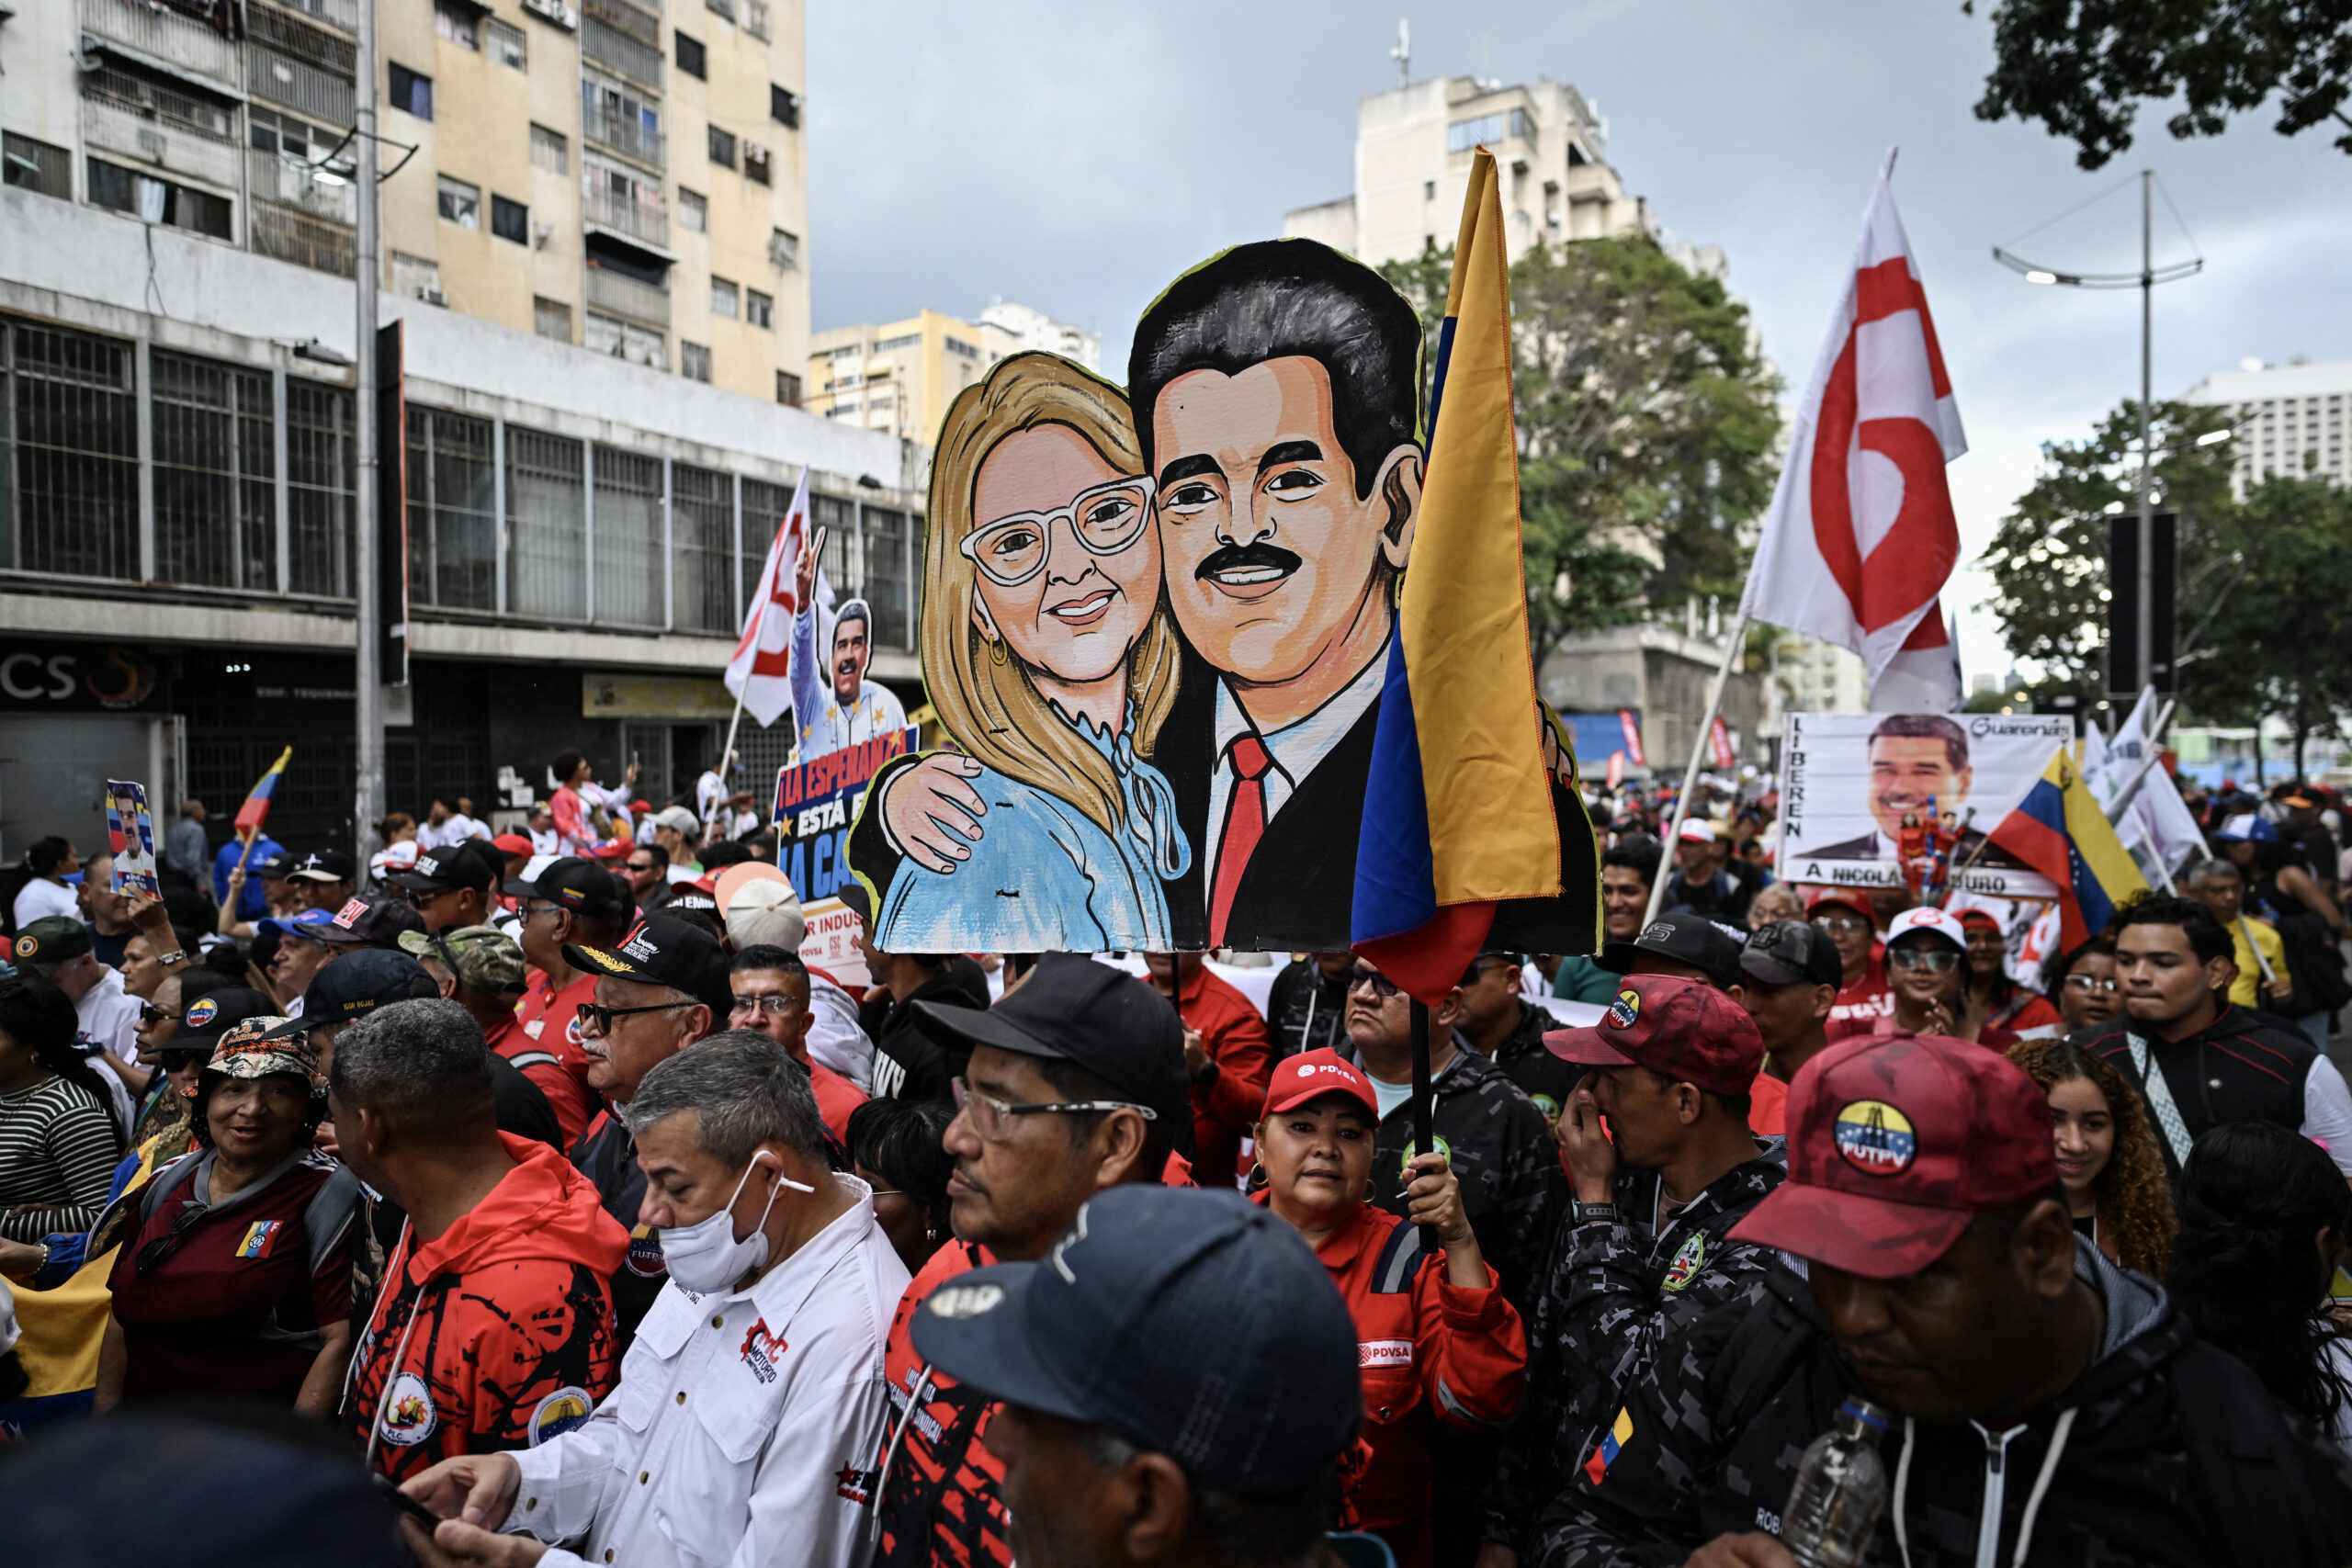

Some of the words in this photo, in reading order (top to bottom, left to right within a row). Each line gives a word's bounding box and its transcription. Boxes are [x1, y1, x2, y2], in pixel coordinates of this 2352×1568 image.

[797, 789, 846, 838] ESTÁ
[851, 791, 865, 822] E
[1805, 863, 1821, 877] A
[820, 911, 863, 934] INDUS
[344, 1001, 356, 1010] IGOR
[356, 998, 375, 1009] ROJAS
[1610, 1007, 1631, 1027] FUTPV
[1319, 1065, 1358, 1084] PDVSA
[1842, 1141, 1907, 1168] FUTPV
[251, 1222, 280, 1232] FVF
[1373, 1348, 1409, 1358] PDVSA
[387, 1428, 403, 1440] PLC
[1755, 1506, 1783, 1536] ROB
